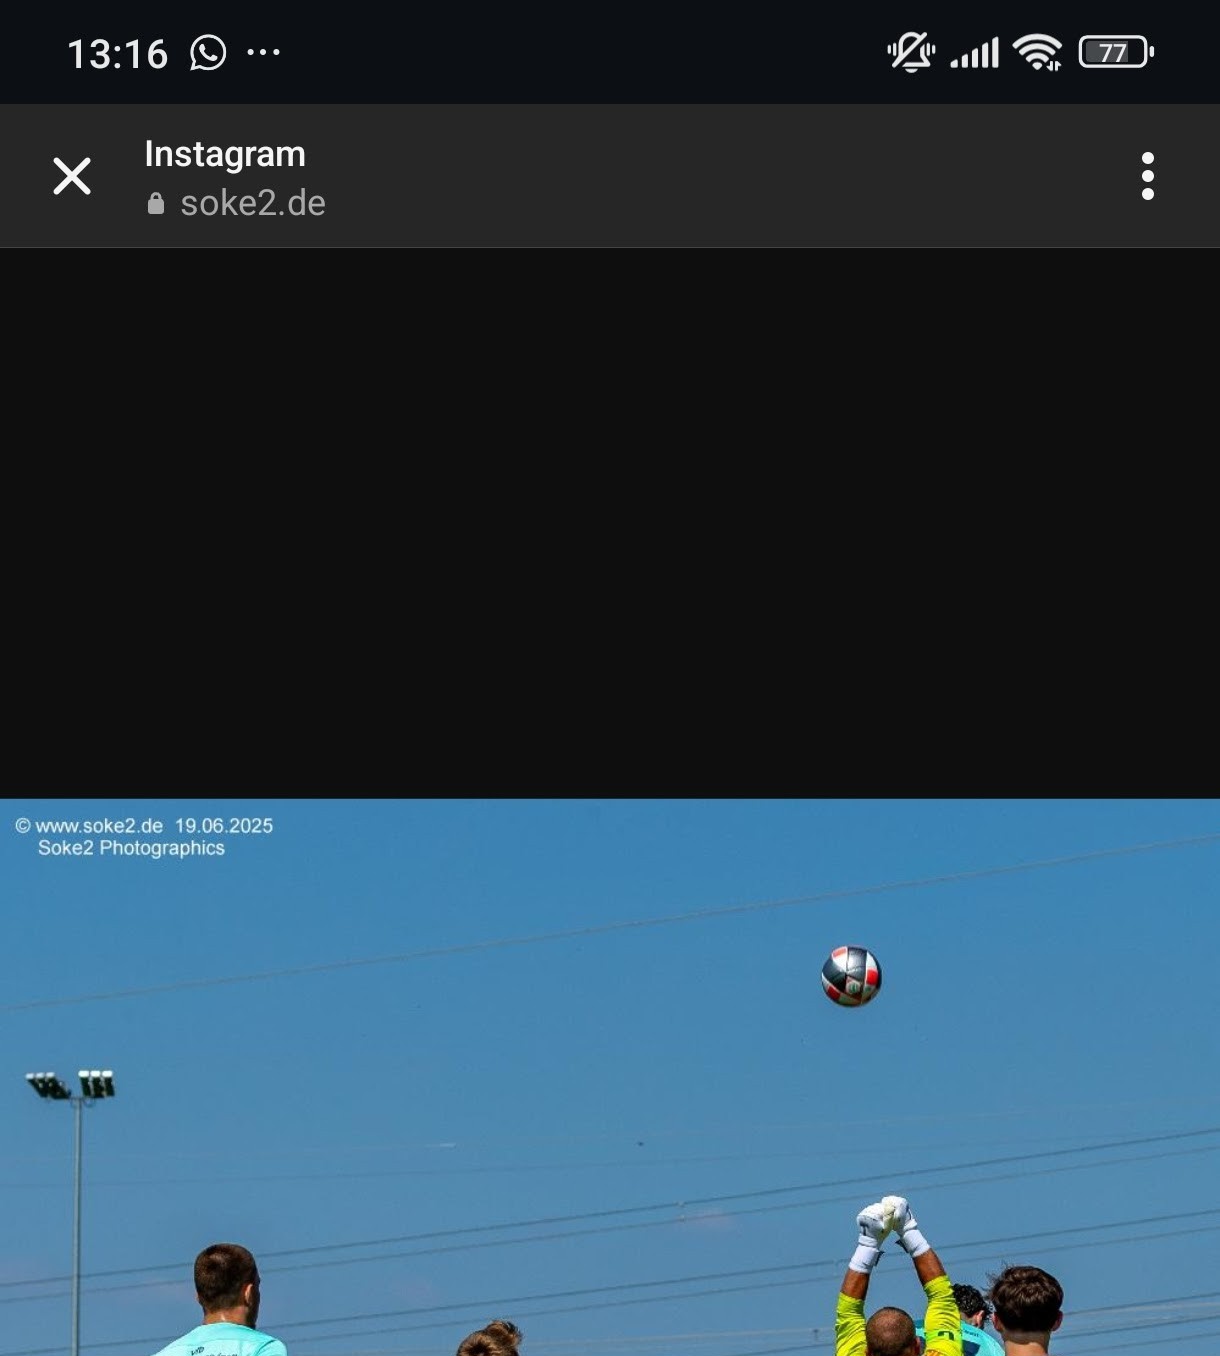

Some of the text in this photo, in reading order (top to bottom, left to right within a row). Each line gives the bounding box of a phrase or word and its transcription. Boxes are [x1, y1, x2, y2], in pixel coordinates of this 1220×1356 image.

[69, 39, 167, 69] 13:16
[1099, 43, 1127, 63] 77
[146, 140, 305, 175] Instagram
[181, 187, 326, 217] soke2.de
